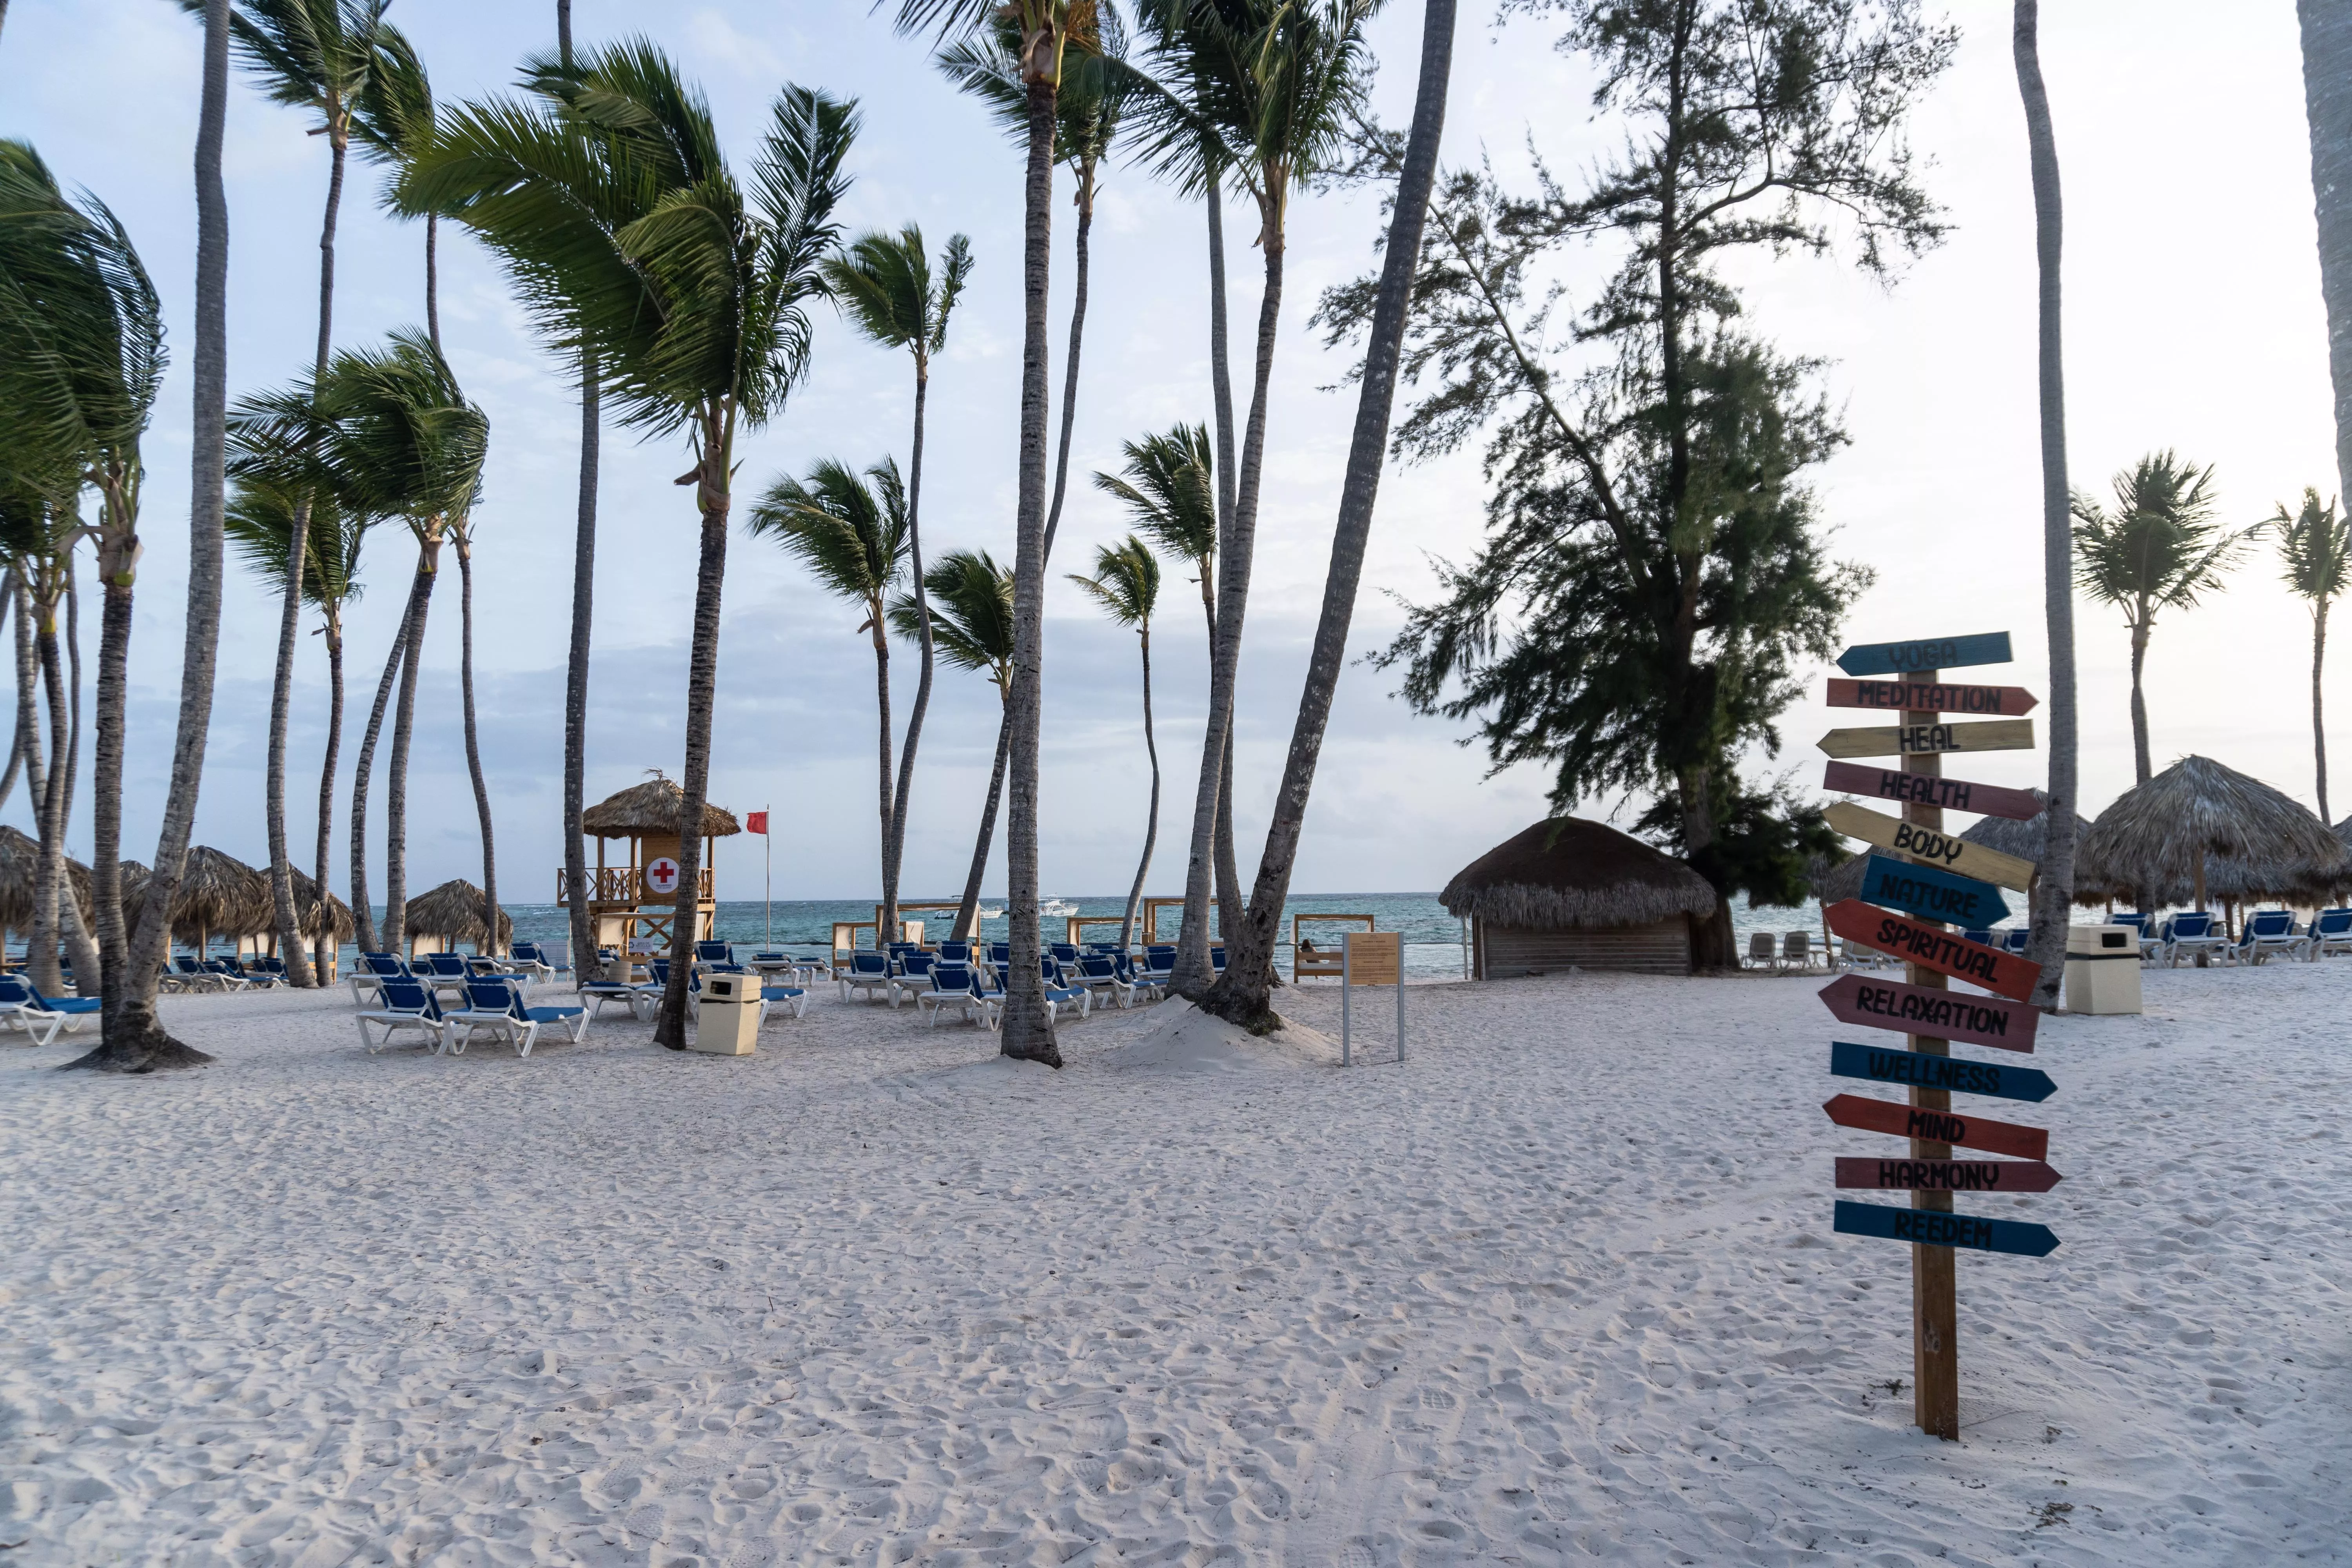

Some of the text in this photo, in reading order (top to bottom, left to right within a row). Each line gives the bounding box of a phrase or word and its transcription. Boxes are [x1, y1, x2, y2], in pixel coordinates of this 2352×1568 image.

[1889, 641, 1958, 670] YOGA
[1858, 681, 2002, 712] MEDITATION
[1900, 725, 1961, 752] HEAL
[1880, 771, 1971, 809] HEALTH
[1894, 823, 1963, 865] BODY
[1879, 873, 1979, 919] NATURE
[1877, 918, 1998, 983] SPIRITUAL
[1857, 985, 2009, 1036] RELAXATION
[1869, 1052, 2000, 1094] WELLNESS
[1907, 1110, 1965, 1142] MIND
[1879, 1161, 1999, 1190] HARMONY
[1895, 1212, 1993, 1248] REEDEM
